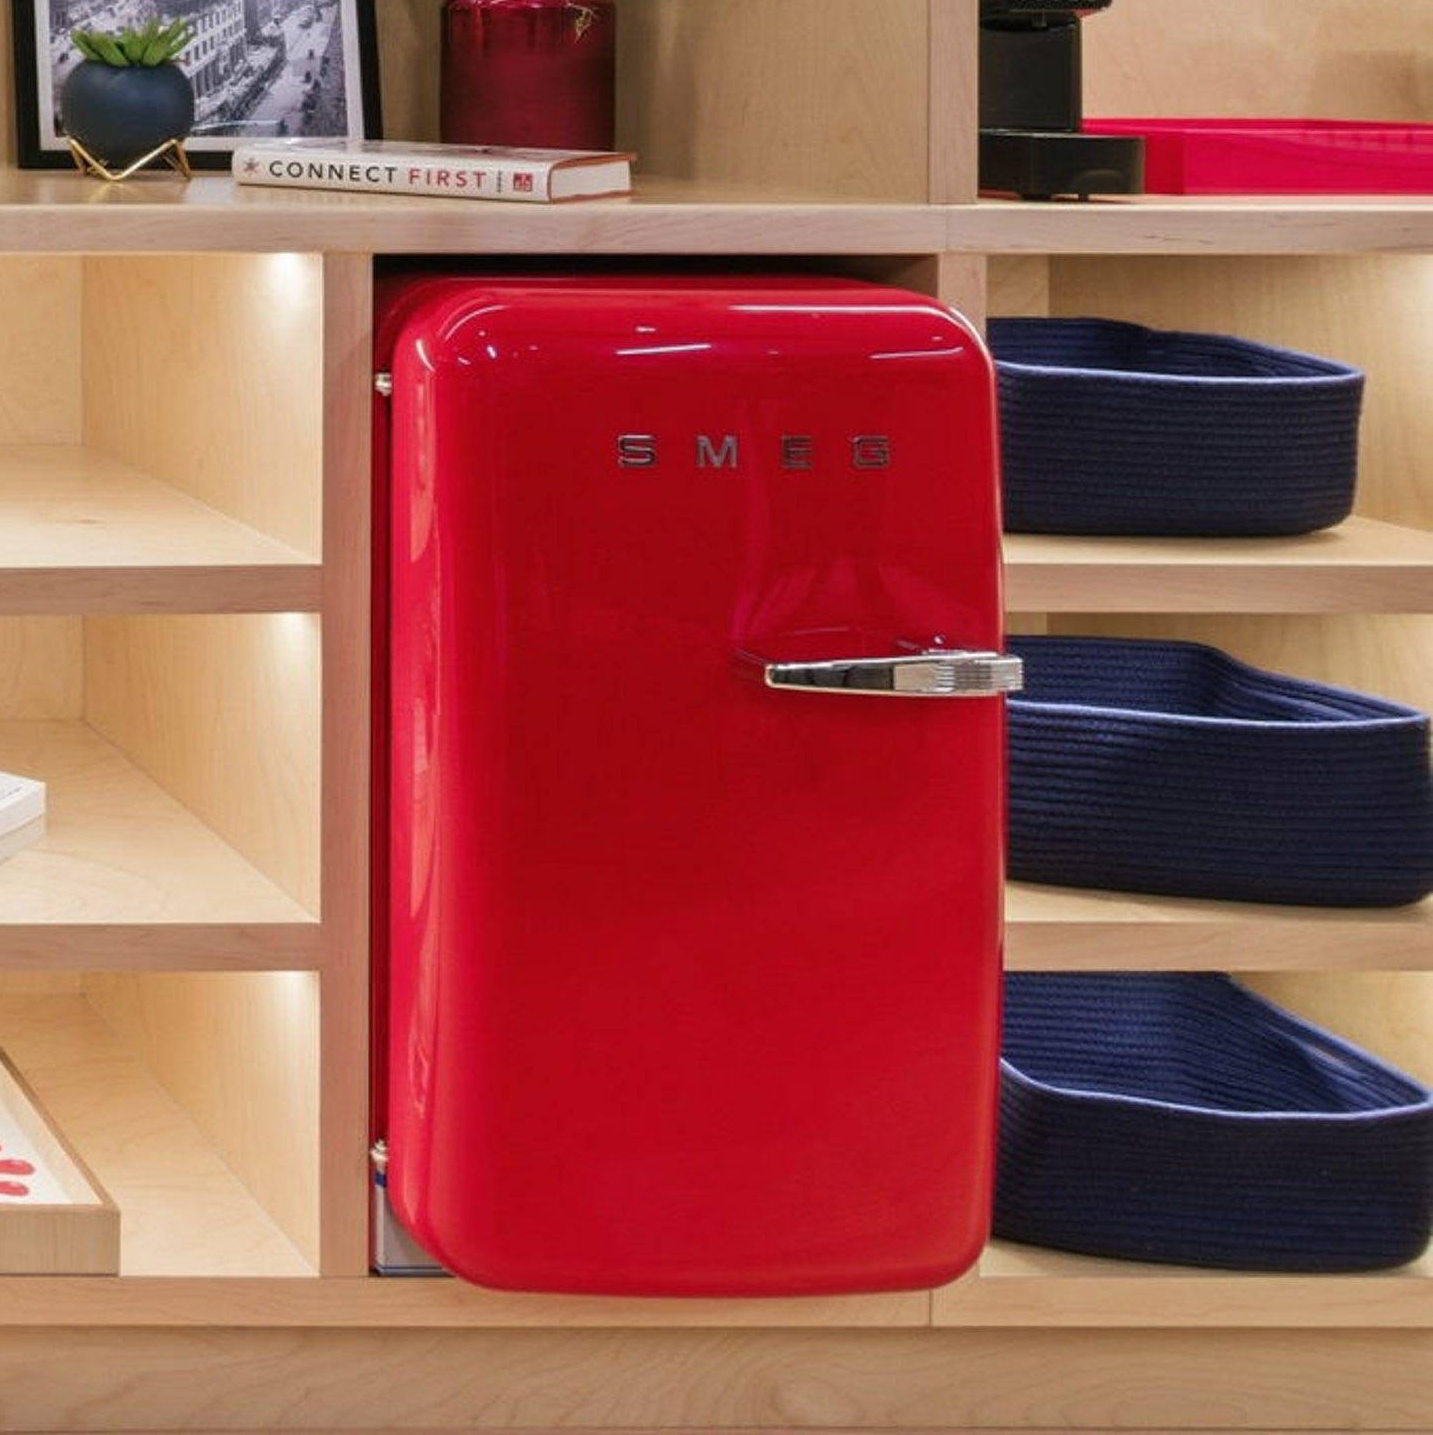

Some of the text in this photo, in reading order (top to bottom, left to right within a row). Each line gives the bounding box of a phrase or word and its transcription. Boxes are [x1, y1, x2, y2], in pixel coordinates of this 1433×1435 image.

[269, 160, 397, 184] CONNECT
[408, 168, 487, 190] FIRST
[617, 435, 891, 468] SMEG
